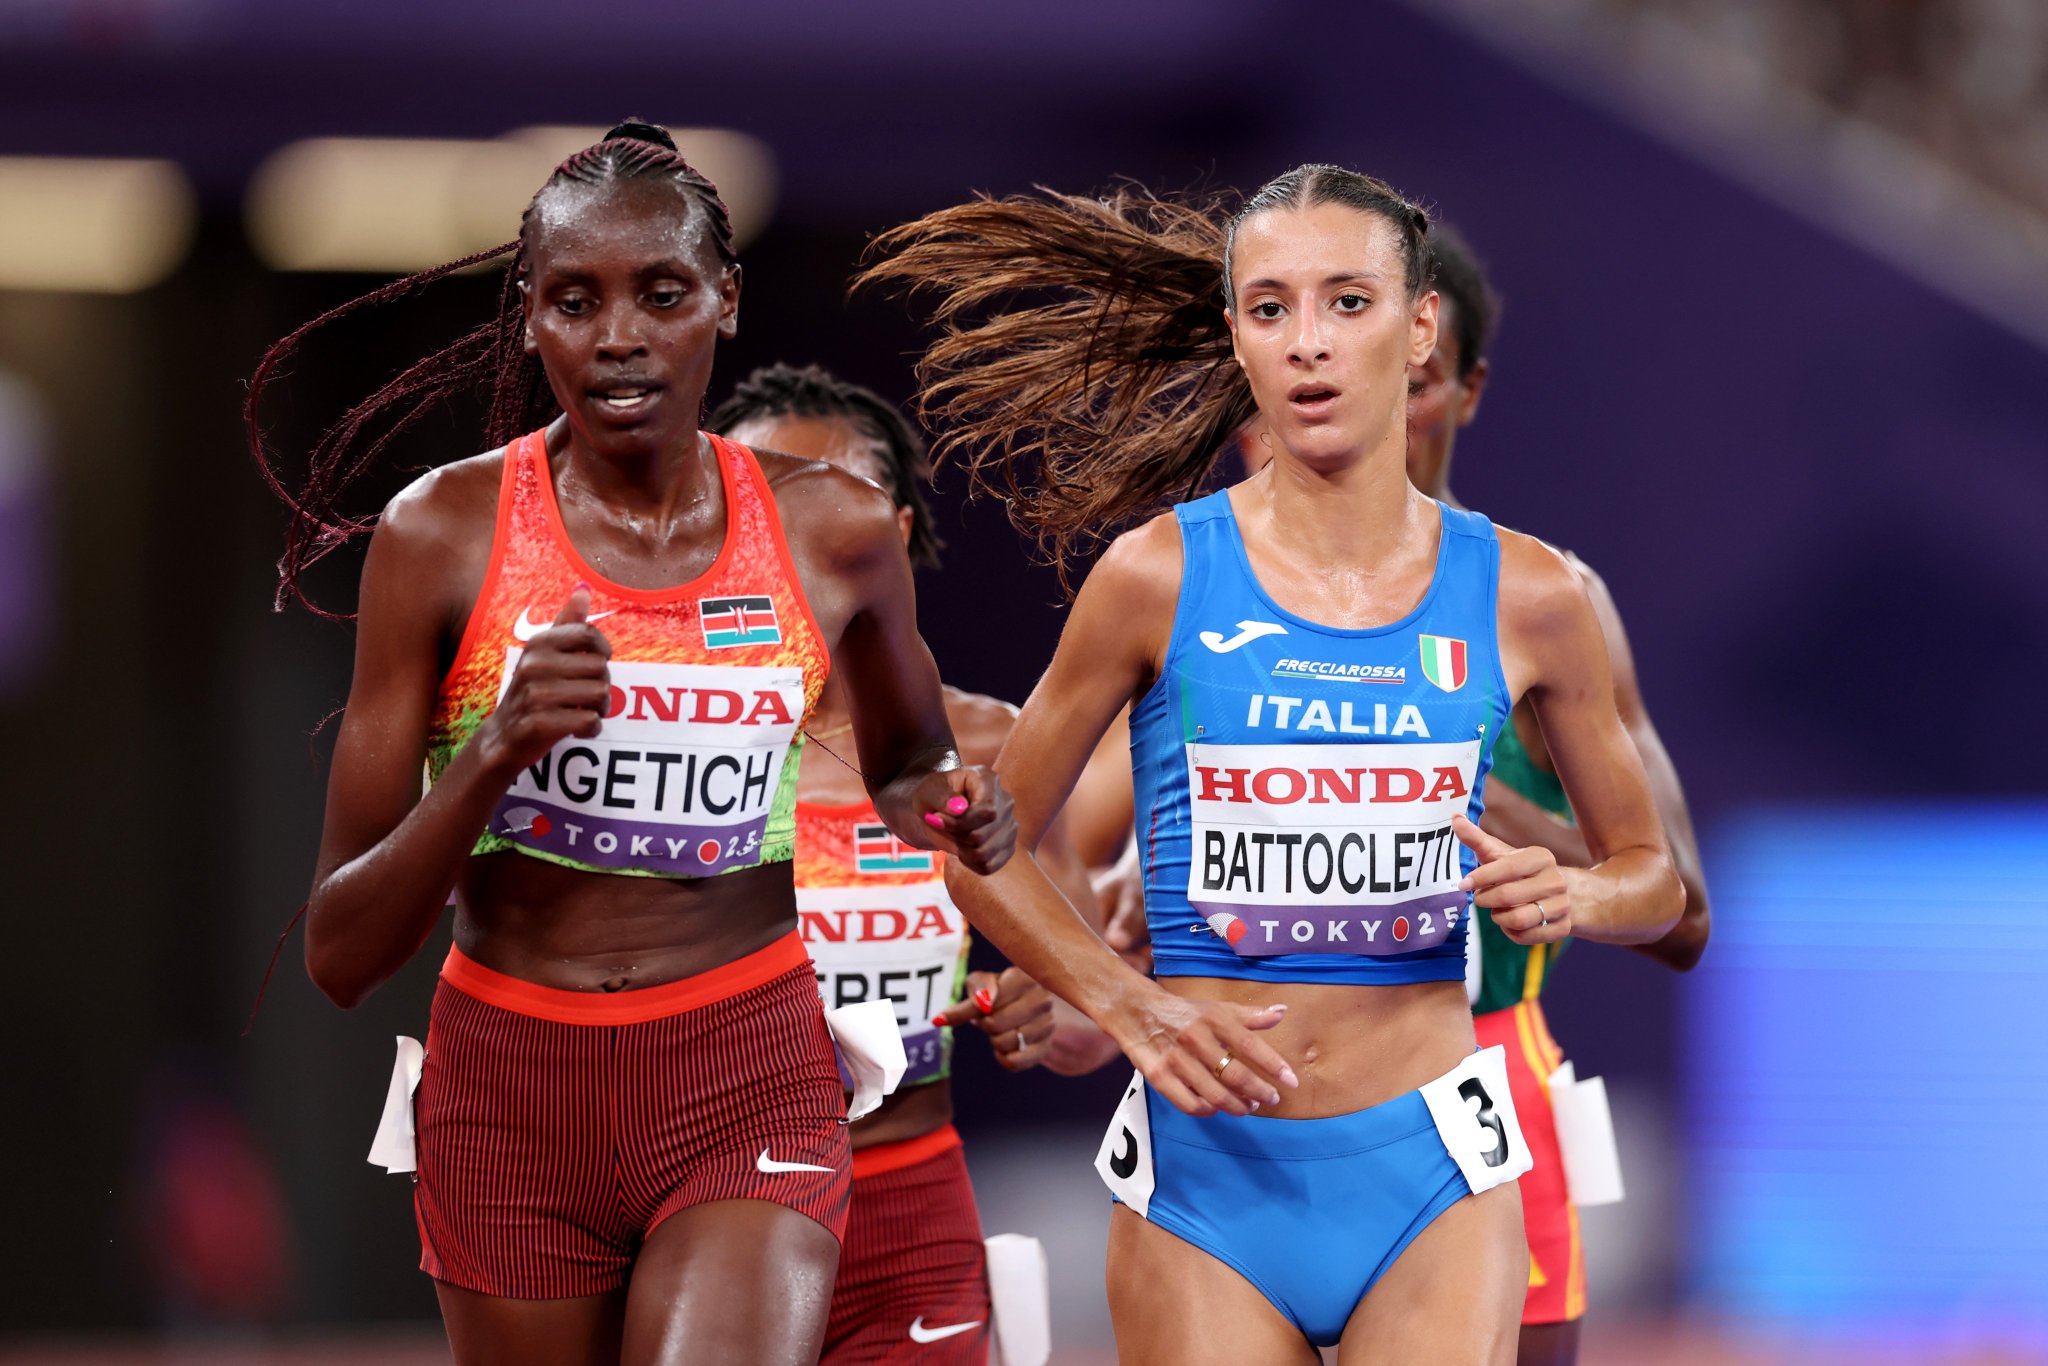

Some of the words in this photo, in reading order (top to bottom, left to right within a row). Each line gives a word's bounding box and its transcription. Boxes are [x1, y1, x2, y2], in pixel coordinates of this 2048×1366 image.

[1275, 659, 1406, 678] FRECCIAROSSA
[1248, 694, 1431, 738] ITALIA
[512, 746, 773, 815] NGETICH
[1195, 766, 1468, 804] HONDA
[1203, 825, 1454, 895] BATTOCLETTI
[798, 905, 954, 943] NDA
[816, 965, 943, 1025] BET
[1457, 1077, 1509, 1168] 3
